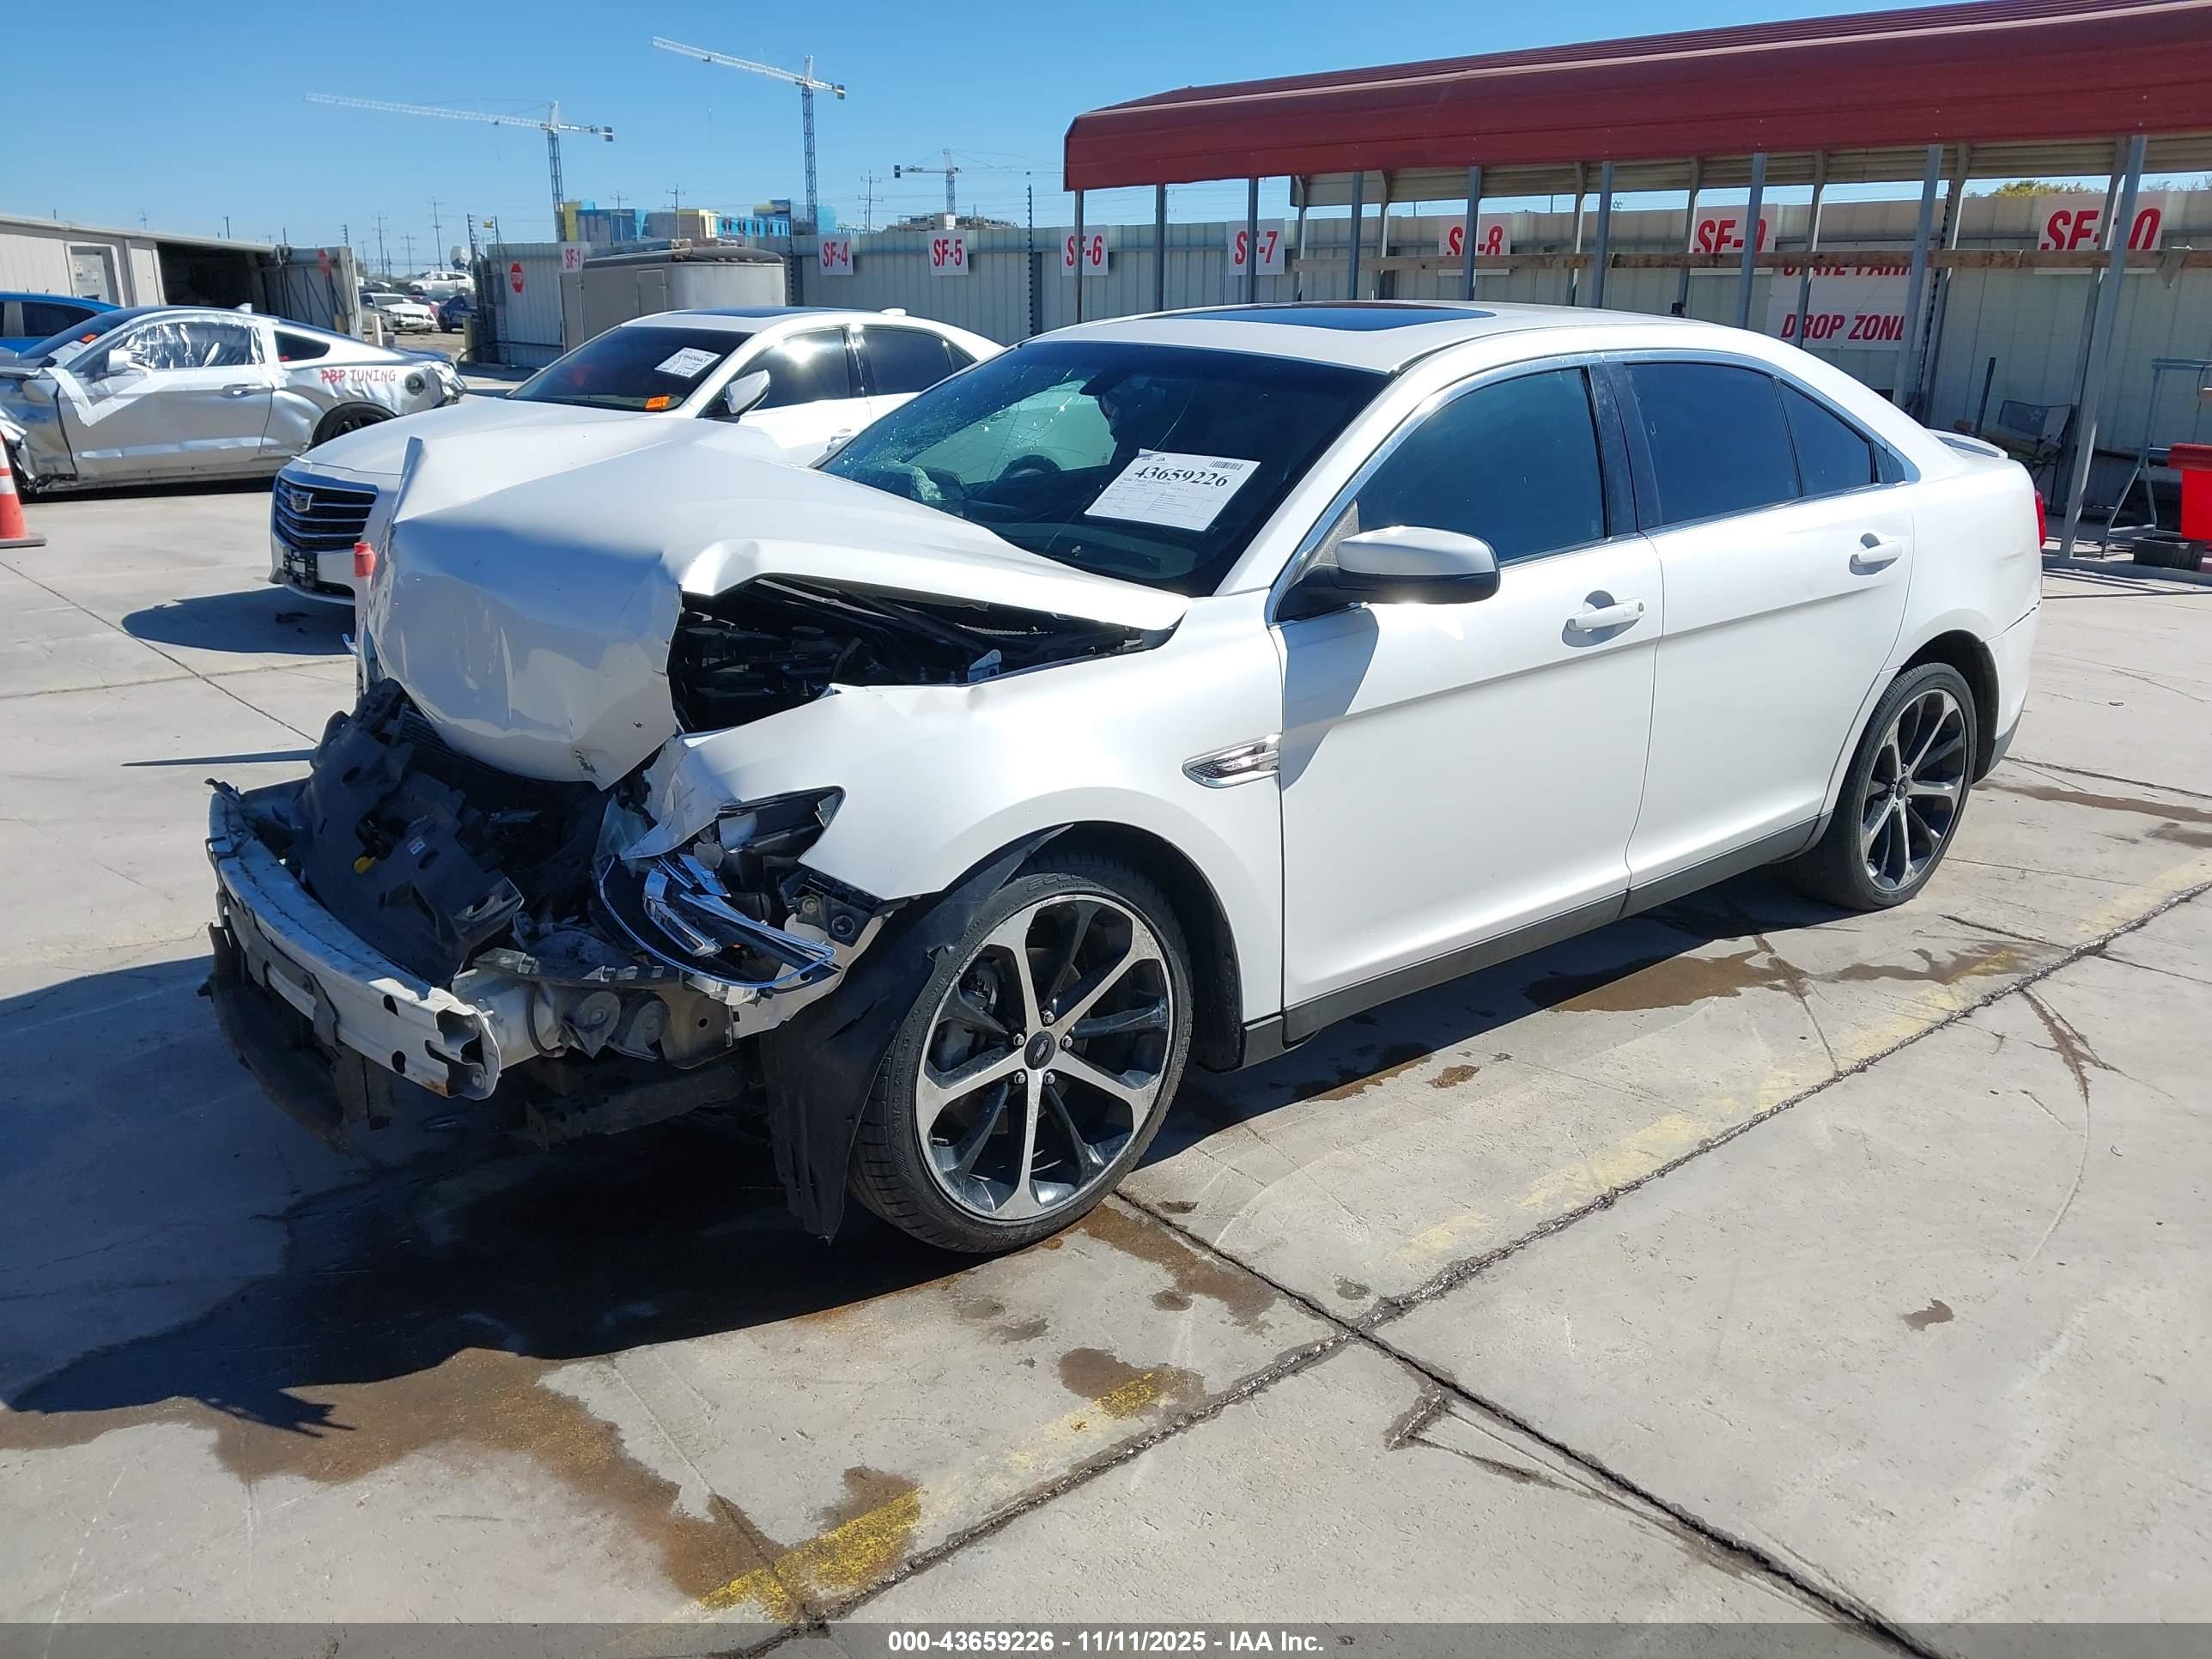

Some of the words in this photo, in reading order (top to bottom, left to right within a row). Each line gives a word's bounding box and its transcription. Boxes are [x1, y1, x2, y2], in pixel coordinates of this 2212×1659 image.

[1446, 226, 1504, 255] S-8
[2040, 208, 2160, 250] SF-0
[565, 247, 581, 269] SF-1
[823, 241, 848, 267] SF-4
[933, 239, 963, 267] SF-5
[1235, 230, 1278, 265] S-7
[1781, 313, 1845, 339] DROP
[350, 369, 396, 382] TUNING
[1134, 465, 1234, 488] 43659226
